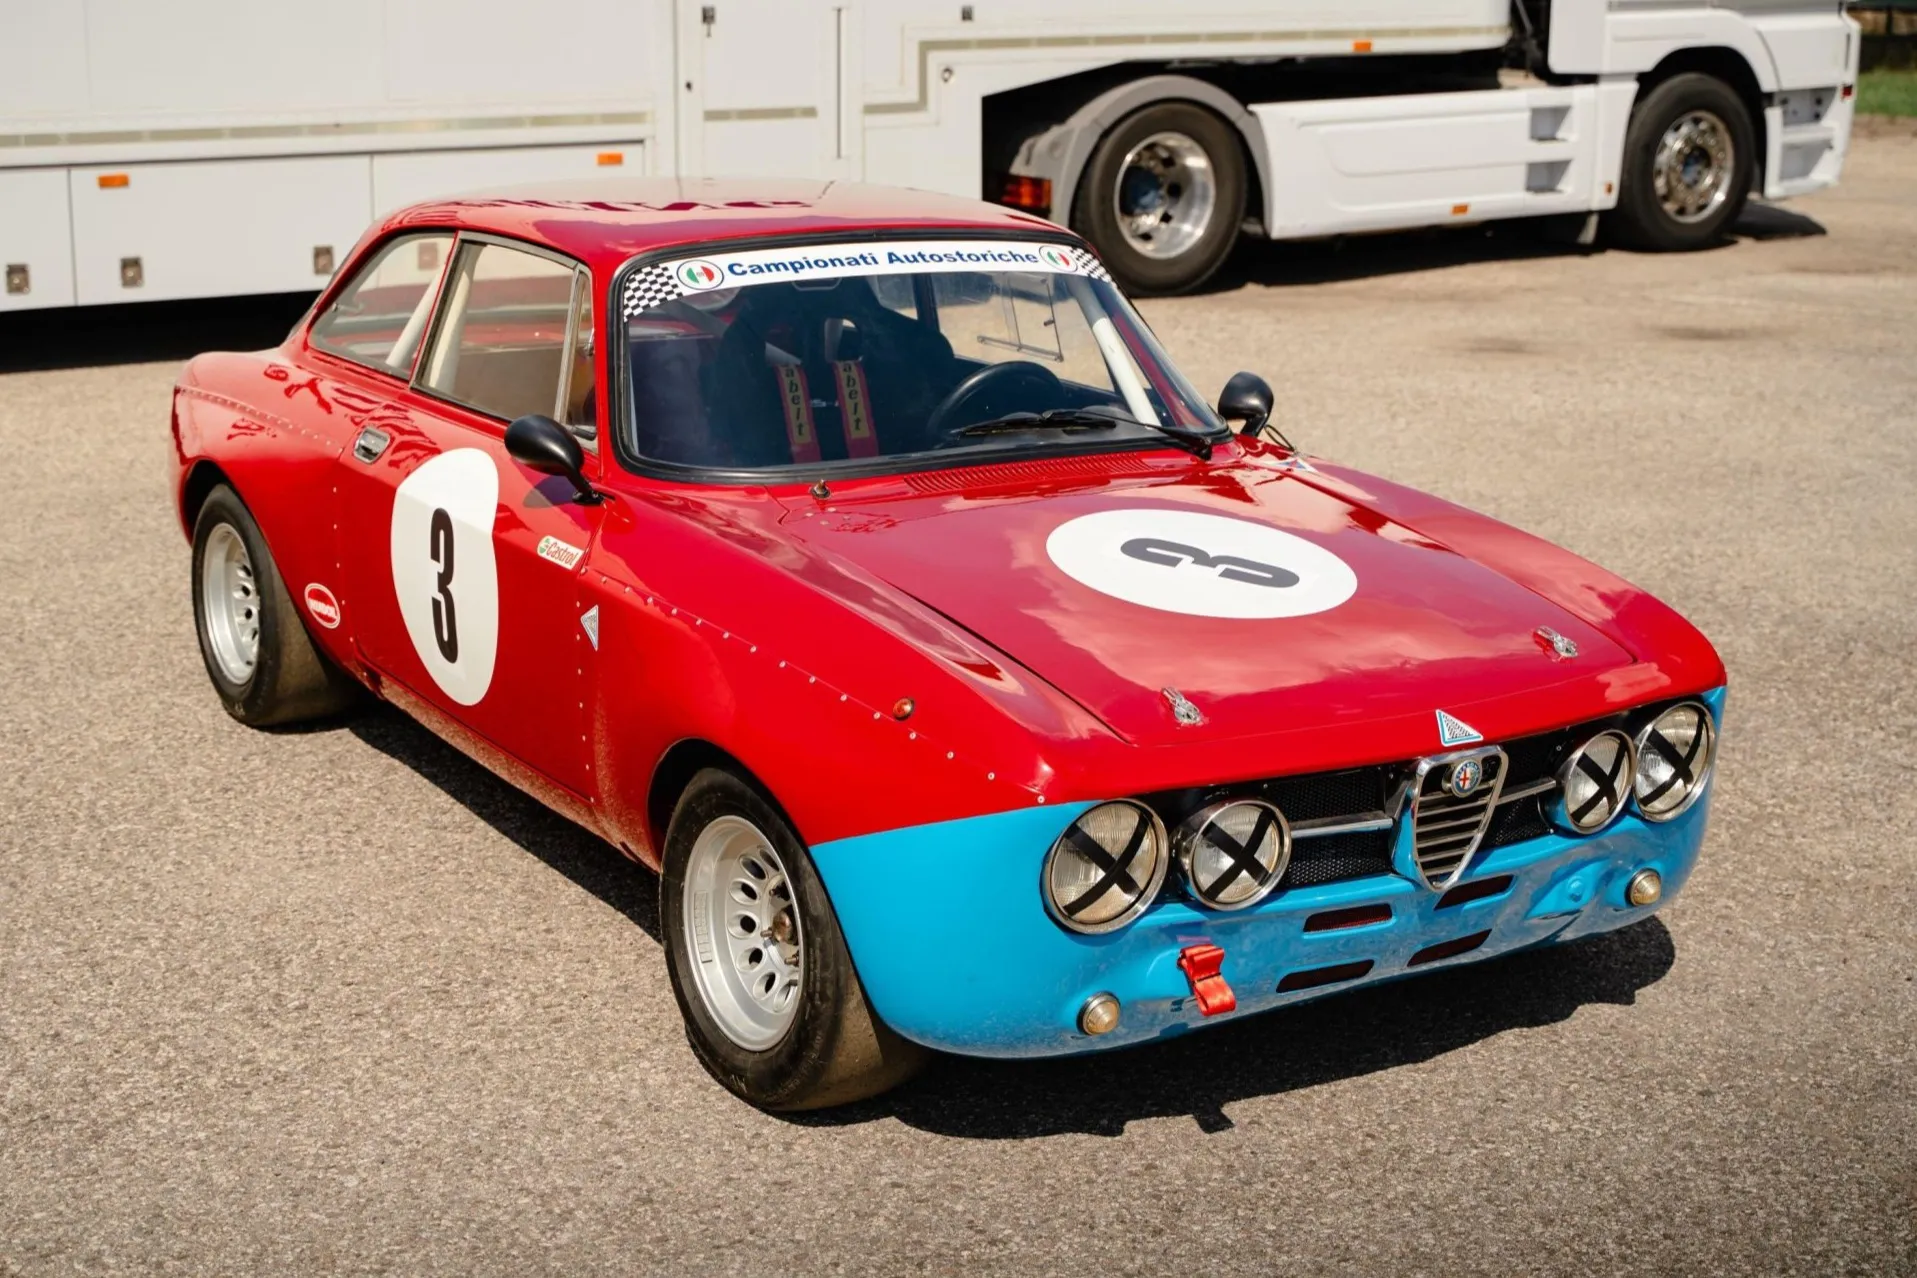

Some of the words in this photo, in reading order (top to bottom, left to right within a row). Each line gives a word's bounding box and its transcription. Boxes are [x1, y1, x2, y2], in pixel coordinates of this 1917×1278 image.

[728, 252, 878, 276] Campionati
[887, 250, 1039, 264] Autostoriche
[546, 541, 579, 566] Castrol
[1120, 538, 1300, 588] 3
[430, 507, 459, 664] 3
